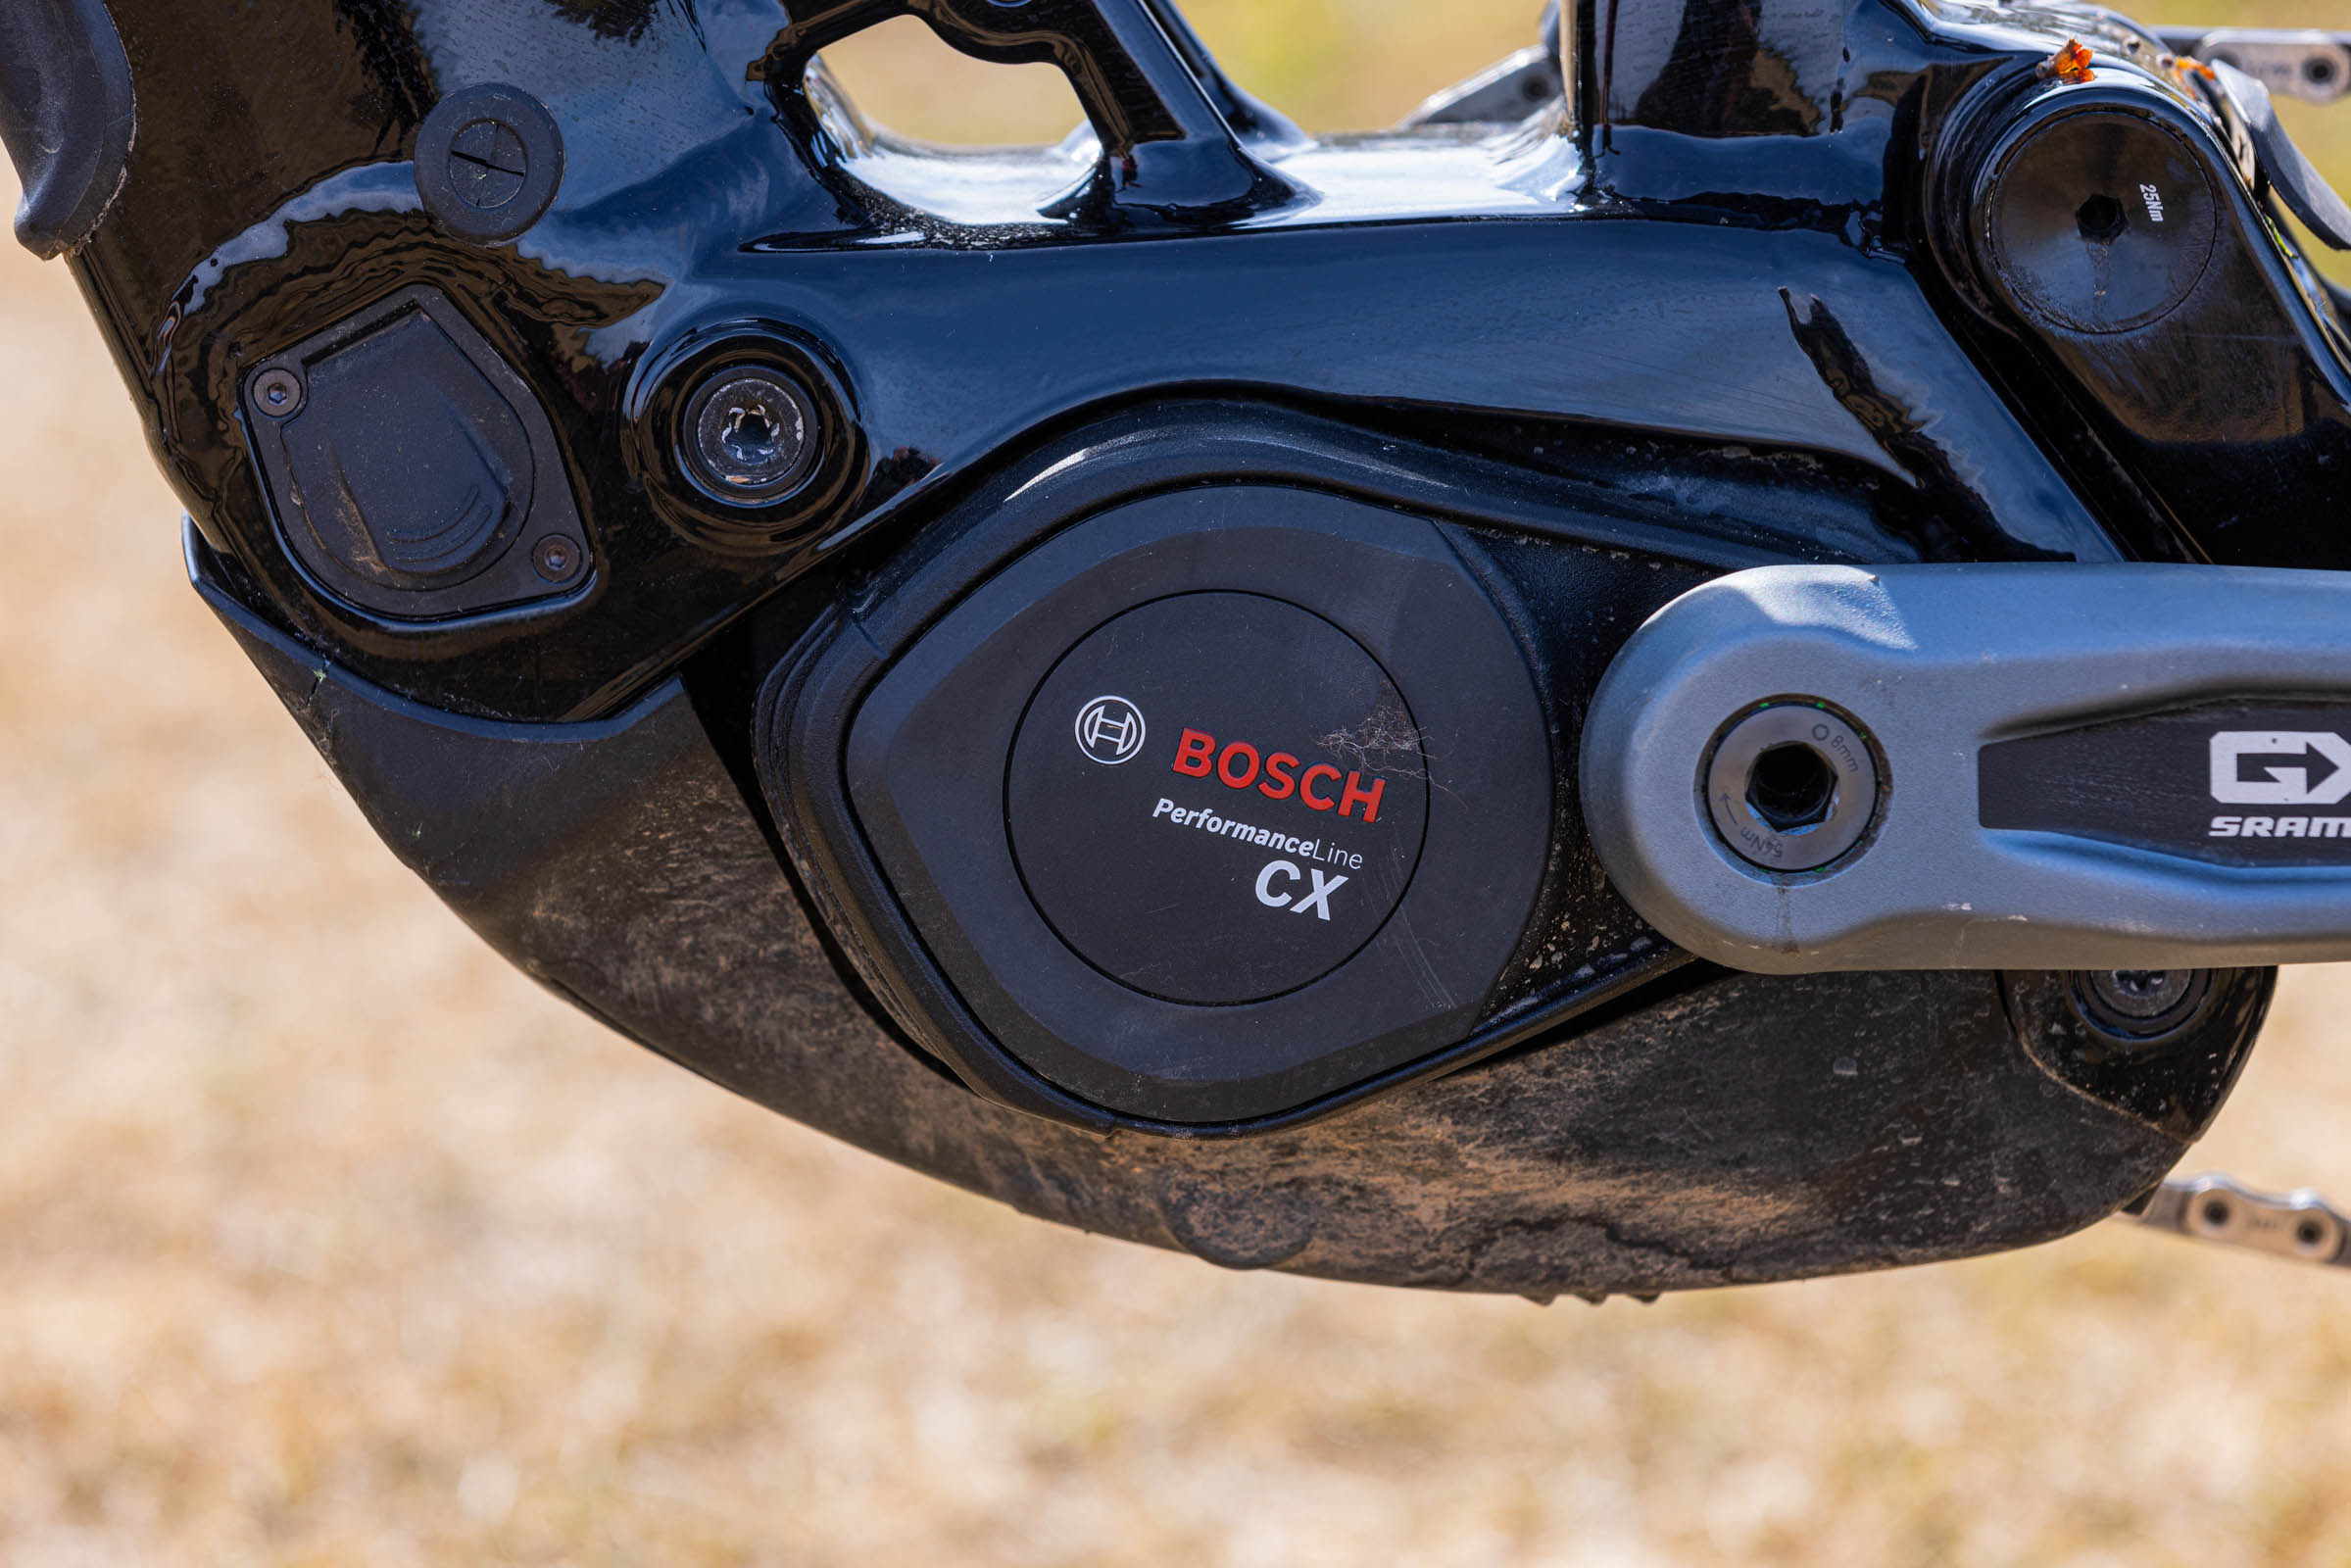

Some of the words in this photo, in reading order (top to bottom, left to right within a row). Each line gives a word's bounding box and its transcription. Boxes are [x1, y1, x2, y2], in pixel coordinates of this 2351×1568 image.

[2139, 183, 2164, 221] 25Nm
[1831, 735, 1859, 772] 8mm
[1171, 726, 1387, 823] BOSCH
[2208, 815, 2351, 838] SRAM
[1255, 859, 1348, 921] CX
